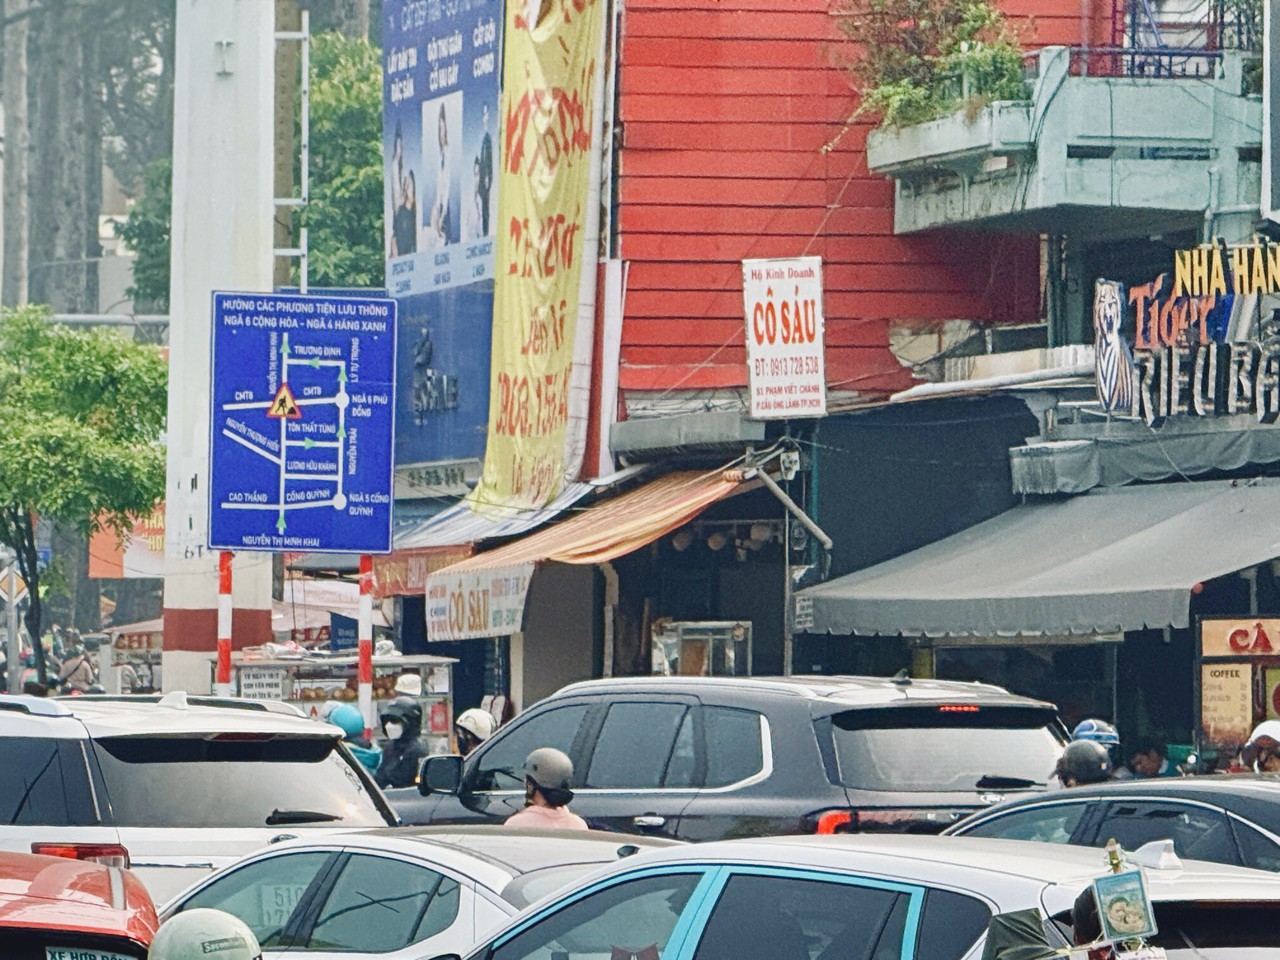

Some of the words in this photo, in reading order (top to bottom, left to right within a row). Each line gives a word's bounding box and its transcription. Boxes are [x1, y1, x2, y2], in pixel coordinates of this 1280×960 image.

[1175, 235, 1227, 297] NHÀ
[751, 269, 763, 283] Hộ
[766, 268, 785, 280] Kinh
[788, 267, 815, 279] Doanh
[223, 298, 255, 311] HƯỚNG
[256, 299, 274, 312] CÁC
[276, 301, 314, 314] PHƯƠNG
[316, 302, 336, 315] TIỆN
[338, 303, 356, 315] LƯU
[358, 303, 388, 317] THÔNG
[224, 314, 244, 326] NGÃ
[246, 317, 251, 326] 6
[252, 316, 277, 329] CỘNG
[307, 318, 326, 330] NGÃ
[328, 321, 333, 330] 4
[362, 321, 386, 331] XANH
[753, 286, 777, 346] CÔ
[781, 285, 816, 345] SÁU
[294, 345, 322, 356] TRƯƠNG
[324, 346, 341, 357] ĐỊNH
[351, 337, 360, 359] TRỌNG
[755, 358, 769, 377] ĐT:
[771, 357, 788, 377] 0913
[790, 356, 803, 376] 728
[235, 391, 254, 402] CMT8
[303, 387, 322, 396] CMT8
[766, 385, 783, 397] PHẠM
[288, 422, 302, 433] TÔN
[304, 421, 318, 433] THẤT
[319, 422, 336, 434] TÙNG
[229, 492, 243, 501] CAO
[244, 489, 268, 503] THẮNG
[286, 491, 305, 502] CỐNG
[306, 488, 330, 499] QUỲNH
[349, 491, 364, 503] NGÃ
[365, 494, 370, 503] 5
[370, 492, 390, 504] CỐNG
[349, 506, 373, 516] QUỲNH
[242, 532, 270, 546] NGUYỄN
[272, 535, 283, 547] THỊ
[284, 536, 302, 546] MINH
[303, 537, 320, 547] KHAI
[1210, 670, 1240, 678] COFFEE
